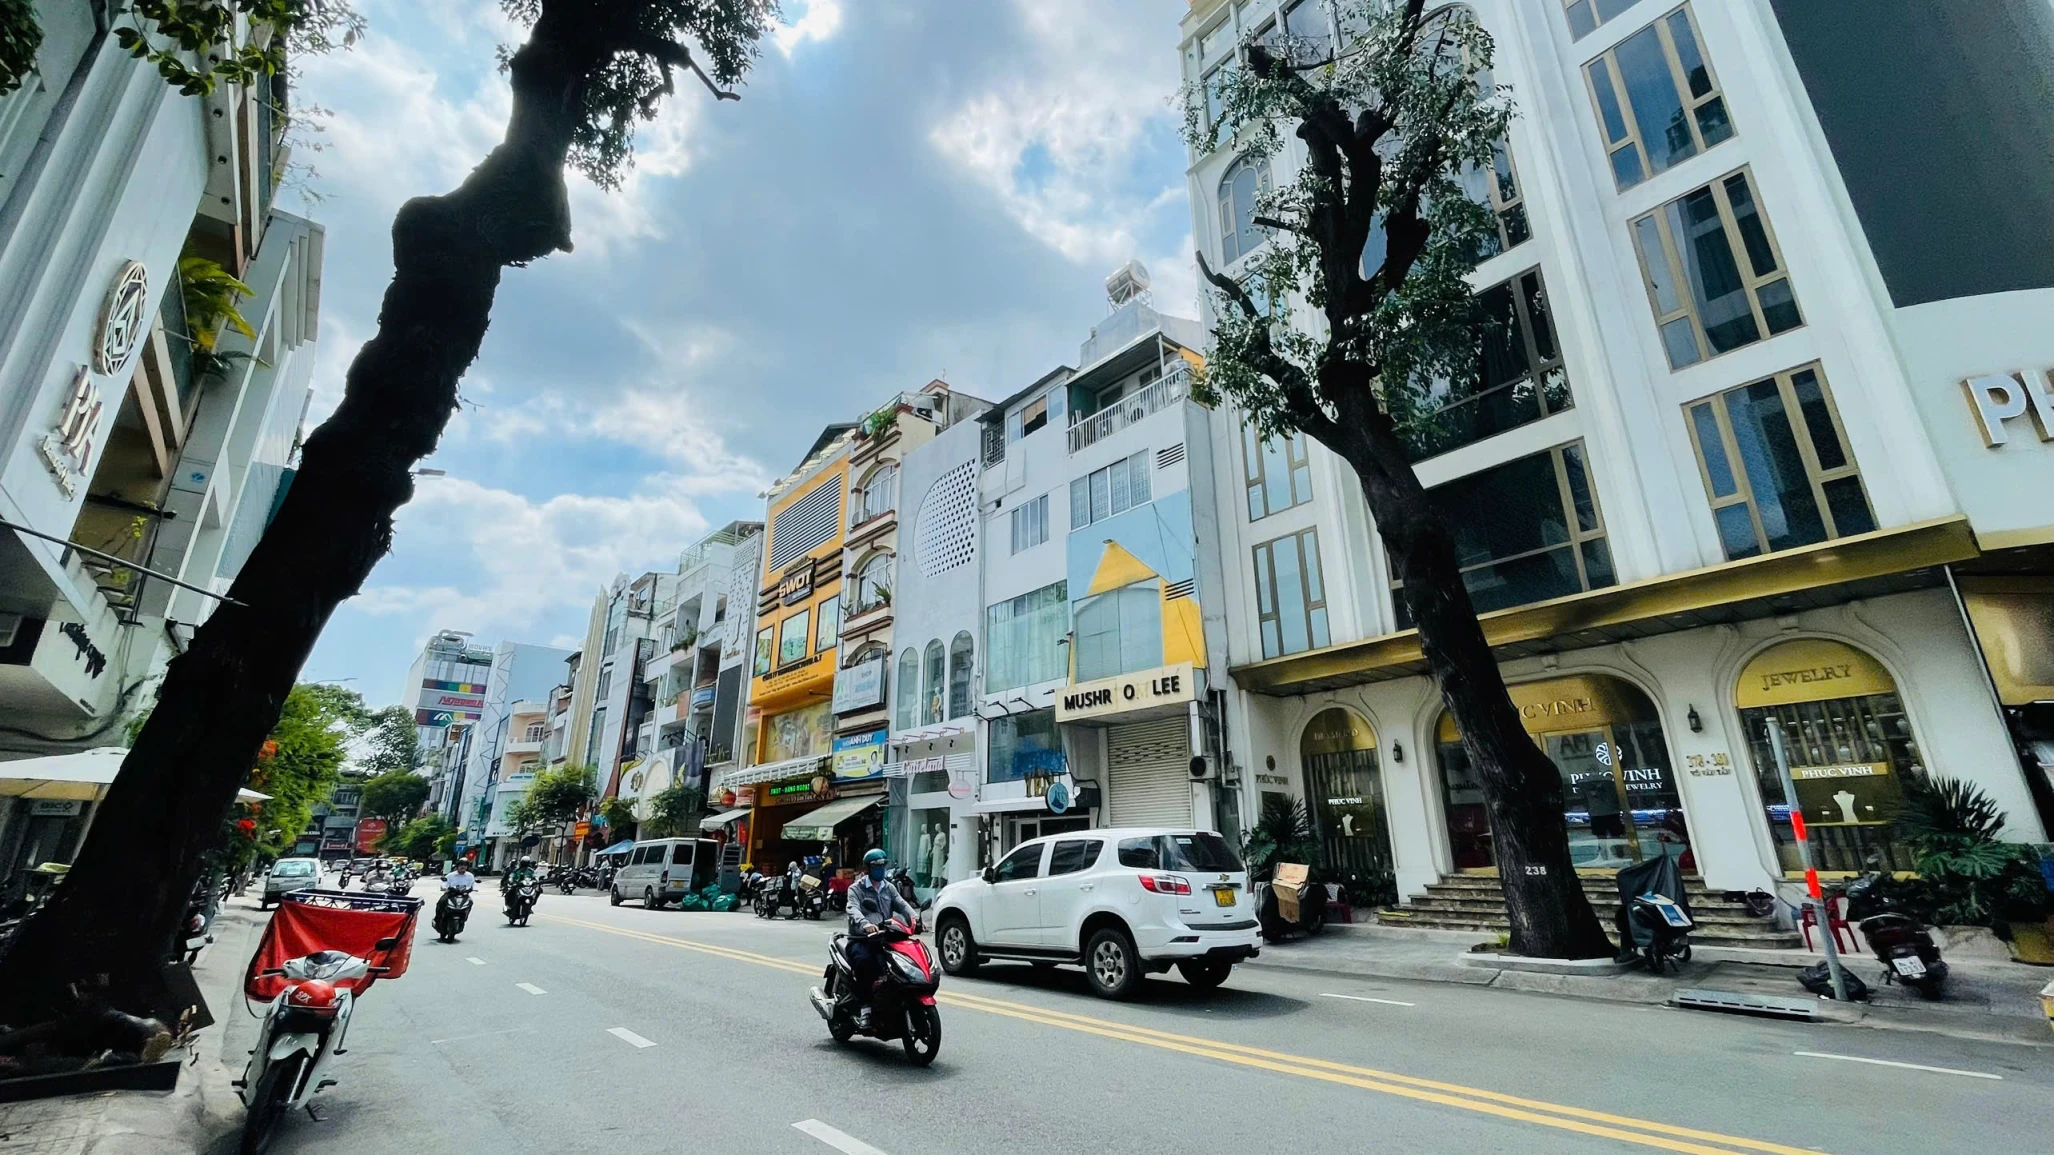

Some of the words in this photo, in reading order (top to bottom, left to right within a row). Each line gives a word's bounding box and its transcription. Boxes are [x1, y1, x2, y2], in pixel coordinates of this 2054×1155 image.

[779, 569, 812, 598] SWOT
[1152, 675, 1180, 696] LEE
[1760, 664, 1852, 691] JEWELRY
[1537, 698, 1595, 716] VINH
[1839, 766, 1873, 776] VINH
[1525, 866, 1547, 875] 238
